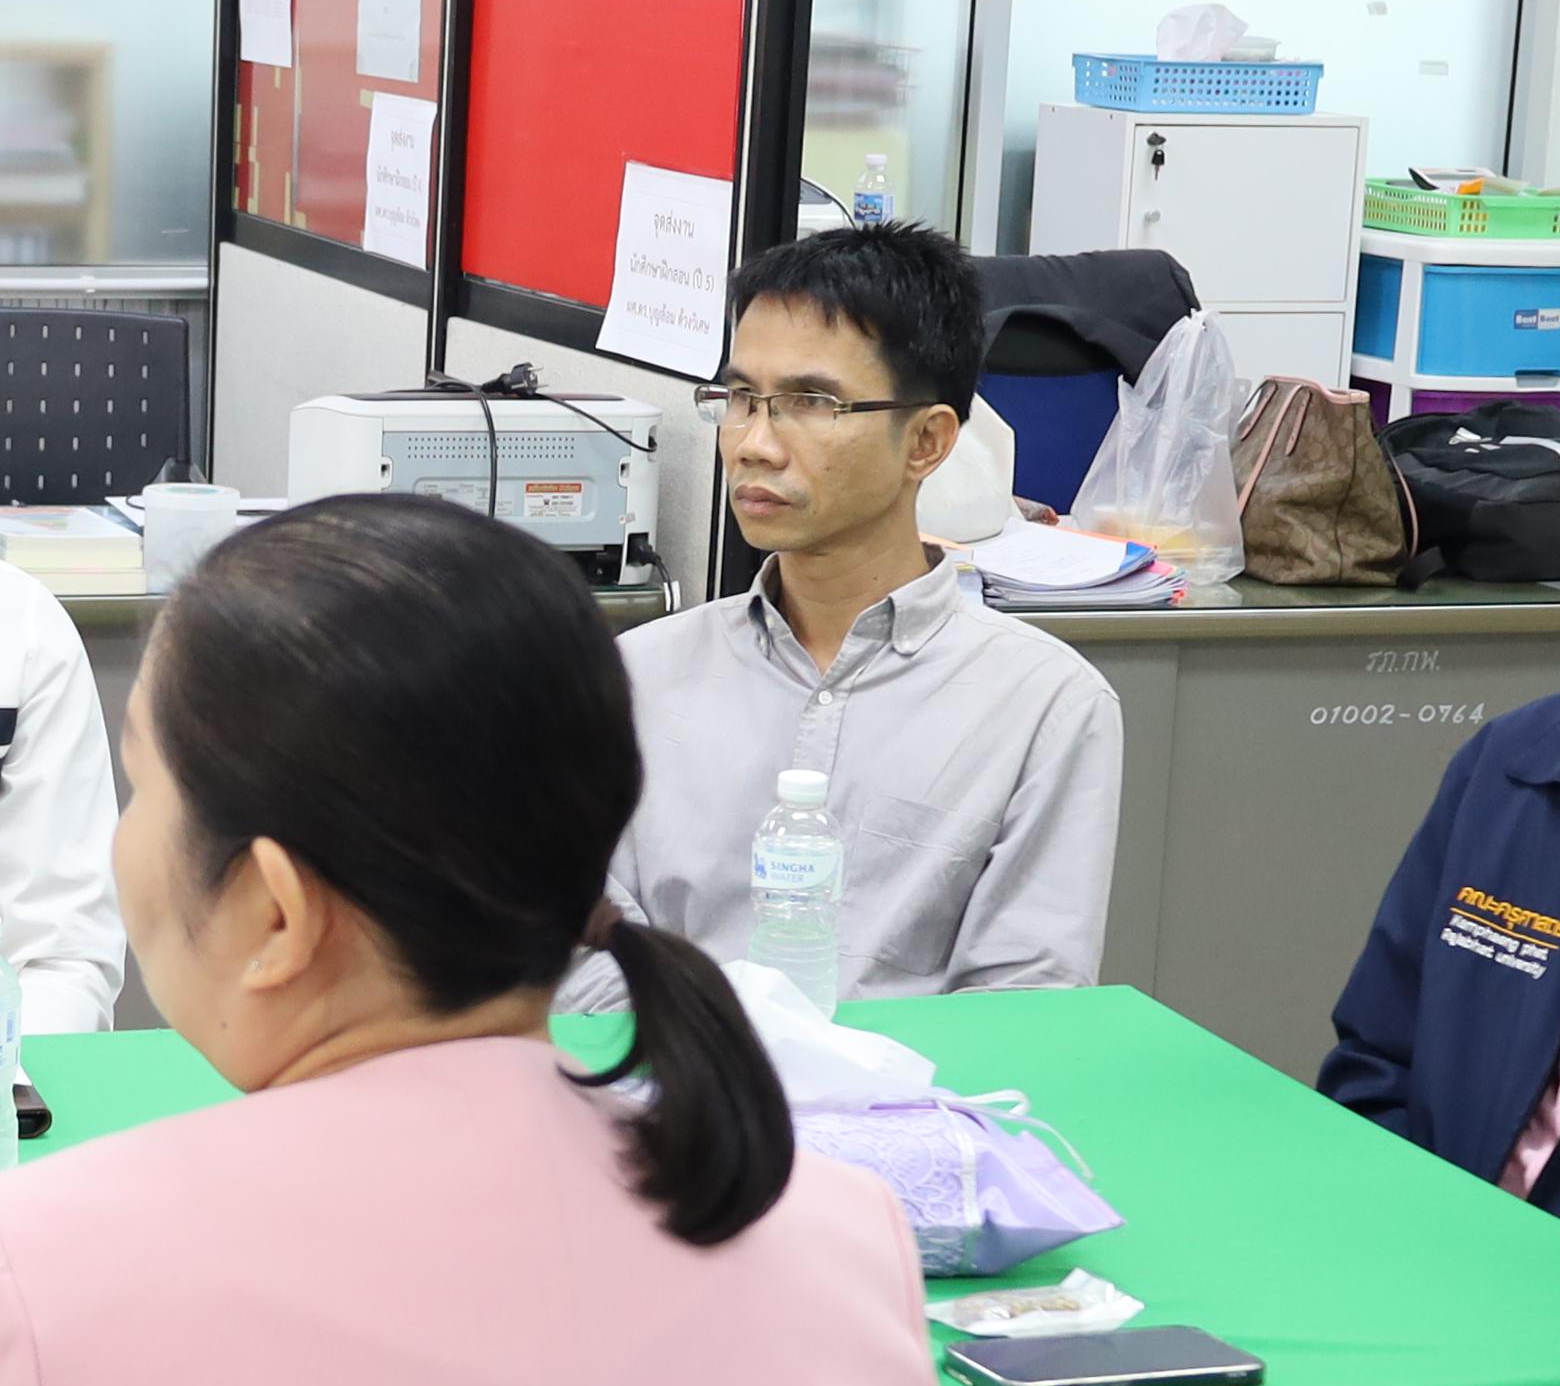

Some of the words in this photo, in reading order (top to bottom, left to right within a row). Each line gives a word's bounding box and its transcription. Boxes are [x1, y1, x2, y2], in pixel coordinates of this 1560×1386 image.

[654, 210, 695, 239] จุดส่งงาน
[630, 253, 690, 286] นักศึกษาฝึกสอน
[769, 861, 816, 874] SINGHA
[770, 872, 804, 883] WATER
